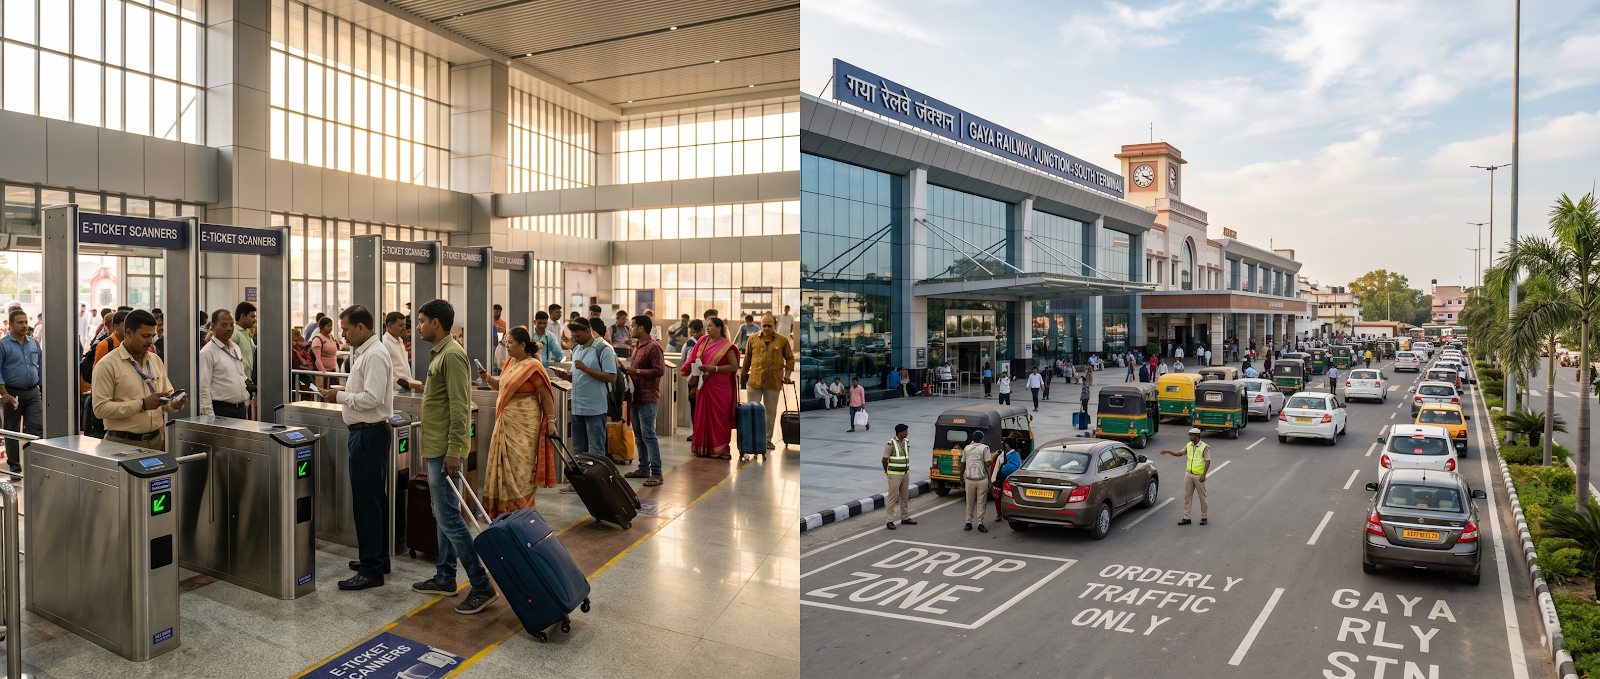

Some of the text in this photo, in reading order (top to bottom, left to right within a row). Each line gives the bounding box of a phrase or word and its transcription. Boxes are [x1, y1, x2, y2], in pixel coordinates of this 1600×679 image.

[846, 74, 955, 132] गया रेलवे जंक्शन
[969, 121, 995, 147] GAYA
[996, 131, 1034, 160] RAILWAY
[1095, 171, 1123, 193] TERMINAL
[82, 221, 178, 240] E-TICKET SCANNERS
[201, 231, 277, 247] E-TICKET SCANNERS
[382, 245, 431, 258] E-TICKET SCANNERS
[461, 252, 483, 262] SCANNERS
[871, 547, 1027, 580] DROP
[1099, 564, 1243, 593] ORDERLY
[804, 571, 985, 615] ZONE
[1077, 582, 1216, 614] TRAFFIC
[1331, 588, 1457, 623] GAYA
[1071, 607, 1172, 636] ONLY
[1336, 616, 1441, 653] RLY
[328, 642, 389, 677] E-TICKET
[344, 644, 412, 679] CANNERS
[1322, 651, 1440, 679] STN
